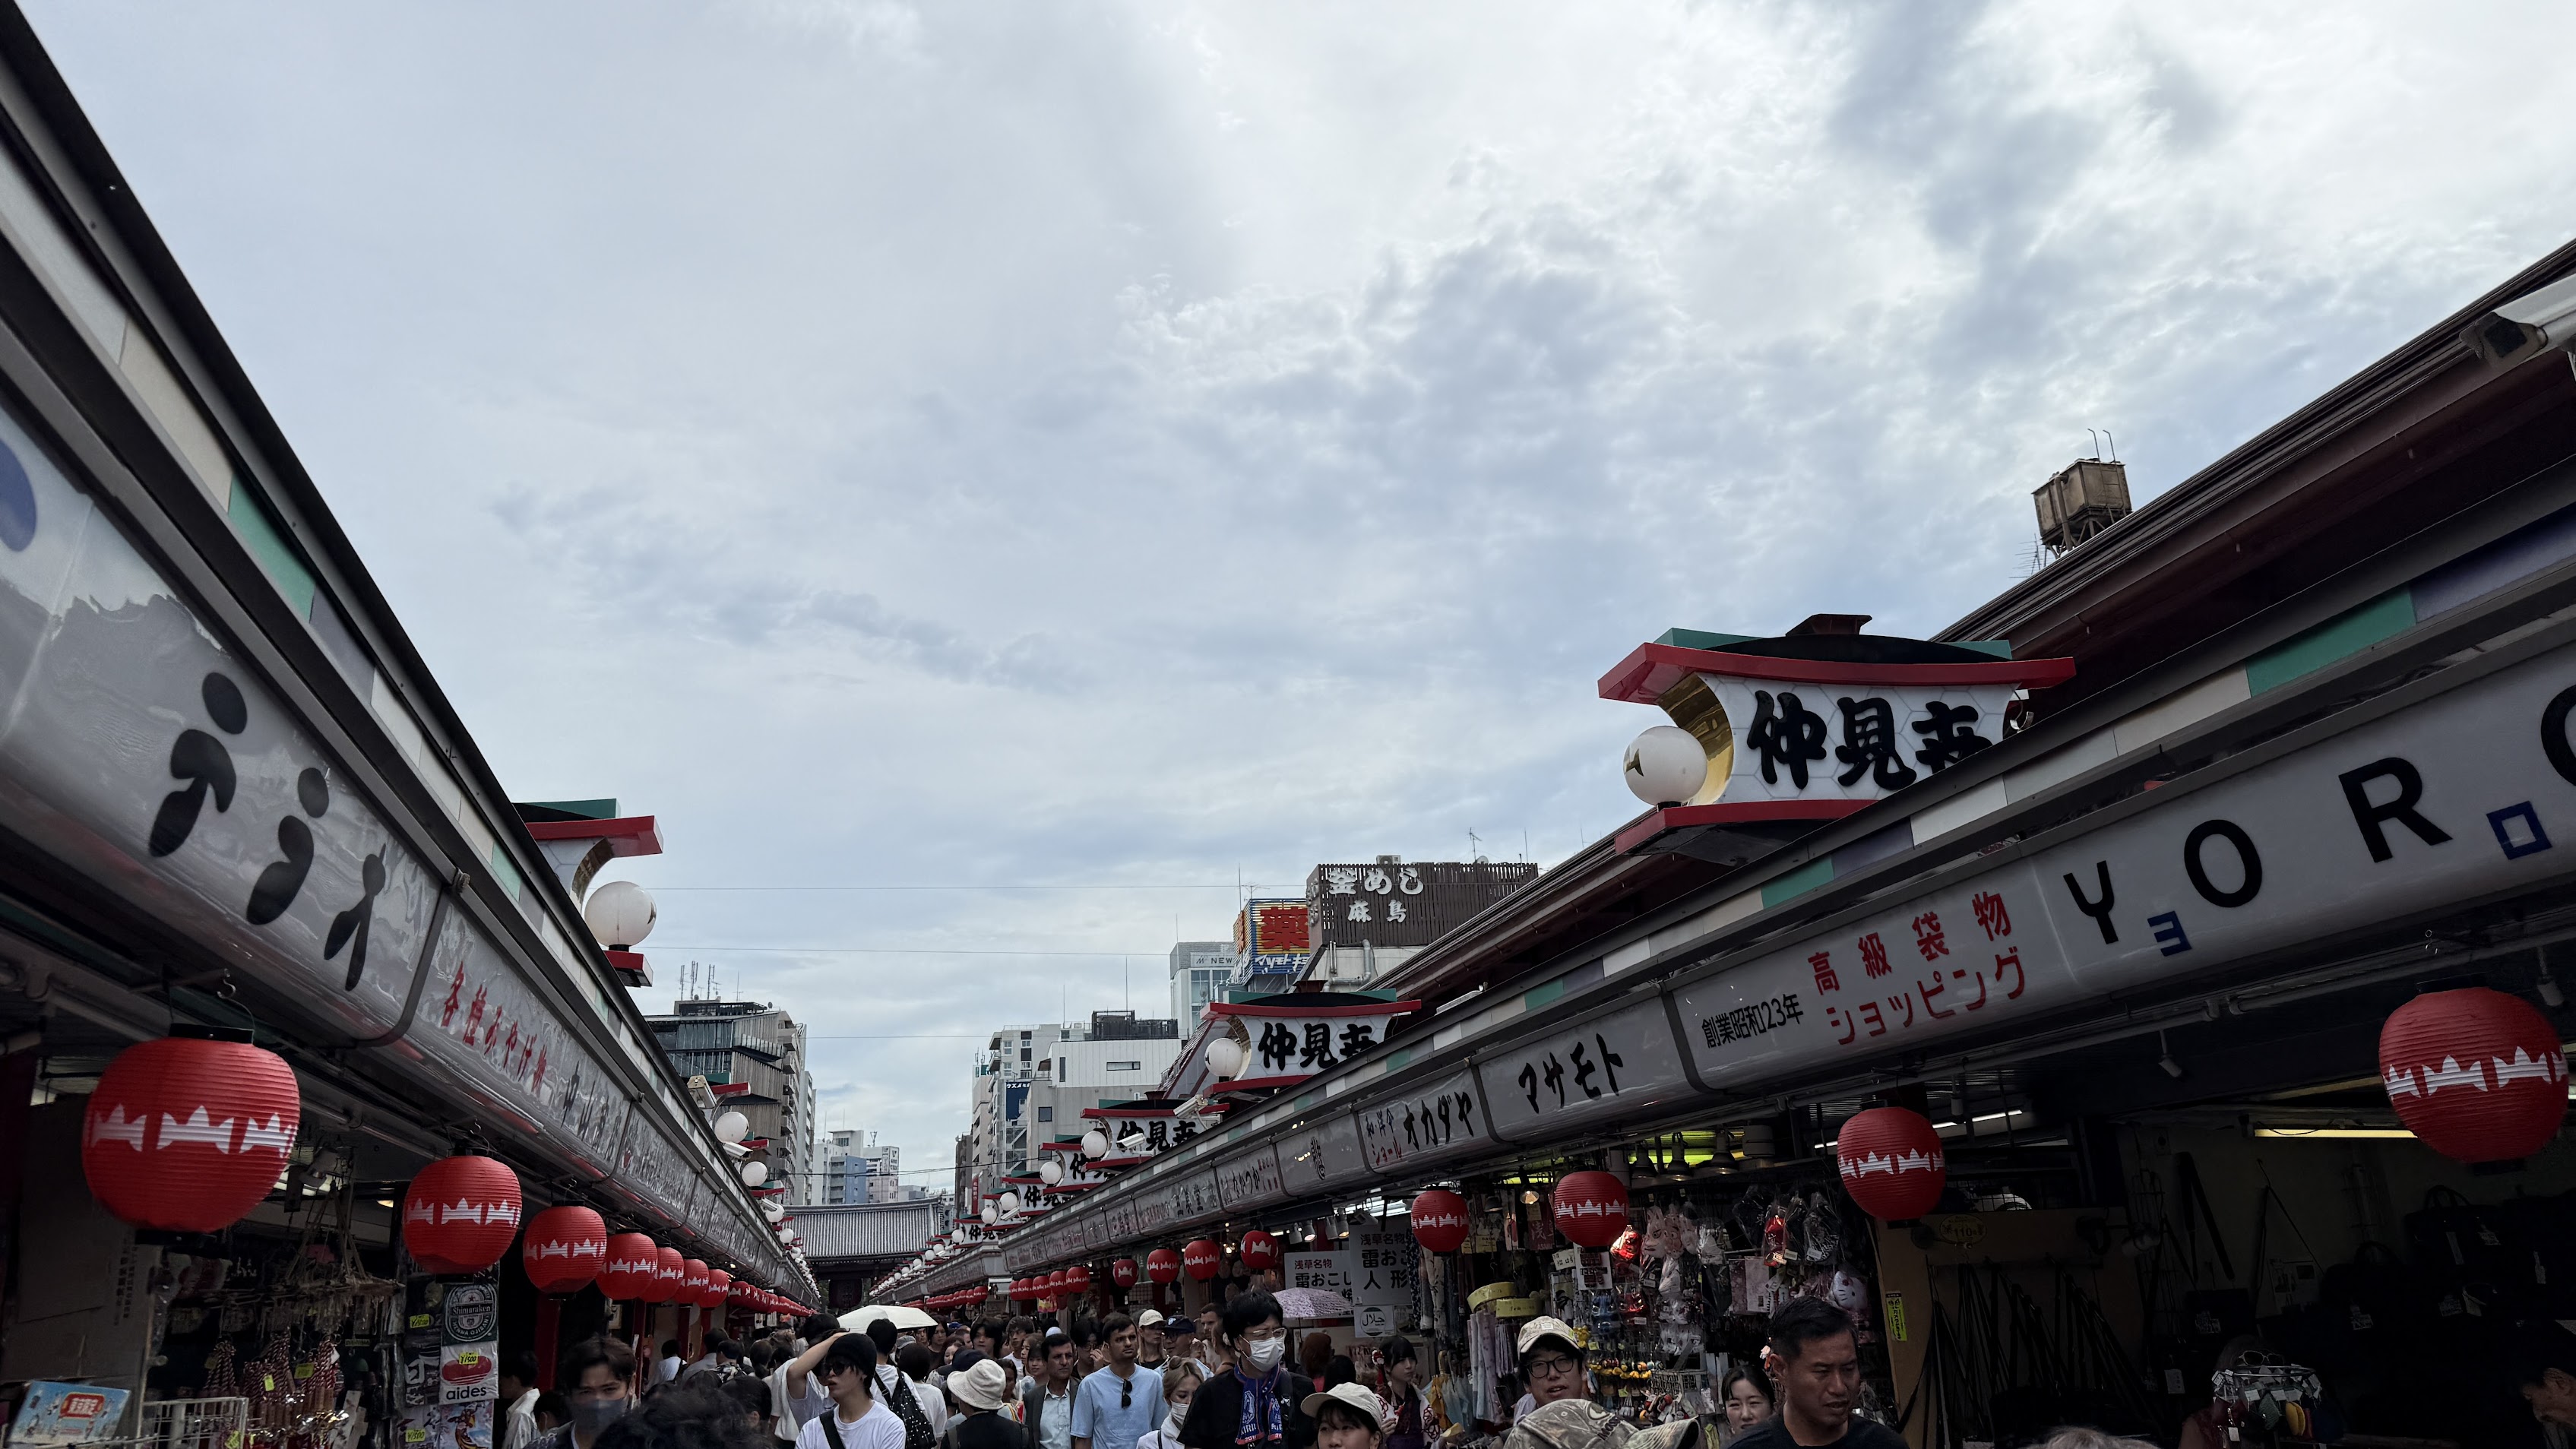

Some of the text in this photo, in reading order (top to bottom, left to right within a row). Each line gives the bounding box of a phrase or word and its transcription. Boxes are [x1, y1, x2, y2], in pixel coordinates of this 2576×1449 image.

[1328, 867, 1424, 895] 釜めし
[1347, 899, 1407, 923] 麻鳥
[1260, 906, 1310, 950] 薬
[1808, 891, 2012, 995] 高級袋物
[1825, 946, 2026, 1046] ショッピング
[1701, 993, 1804, 1049] 創業昭和23年
[1518, 1033, 1624, 1115] マサモト
[1402, 1091, 1474, 1152] オカダヤ
[1360, 1233, 1407, 1246] 浅草名物
[1294, 1258, 1332, 1270] 浅草名物
[1295, 1271, 1352, 1289] 雷おこし
[452, 1304, 491, 1315] Shimuraken
[446, 1386, 487, 1400] aides
